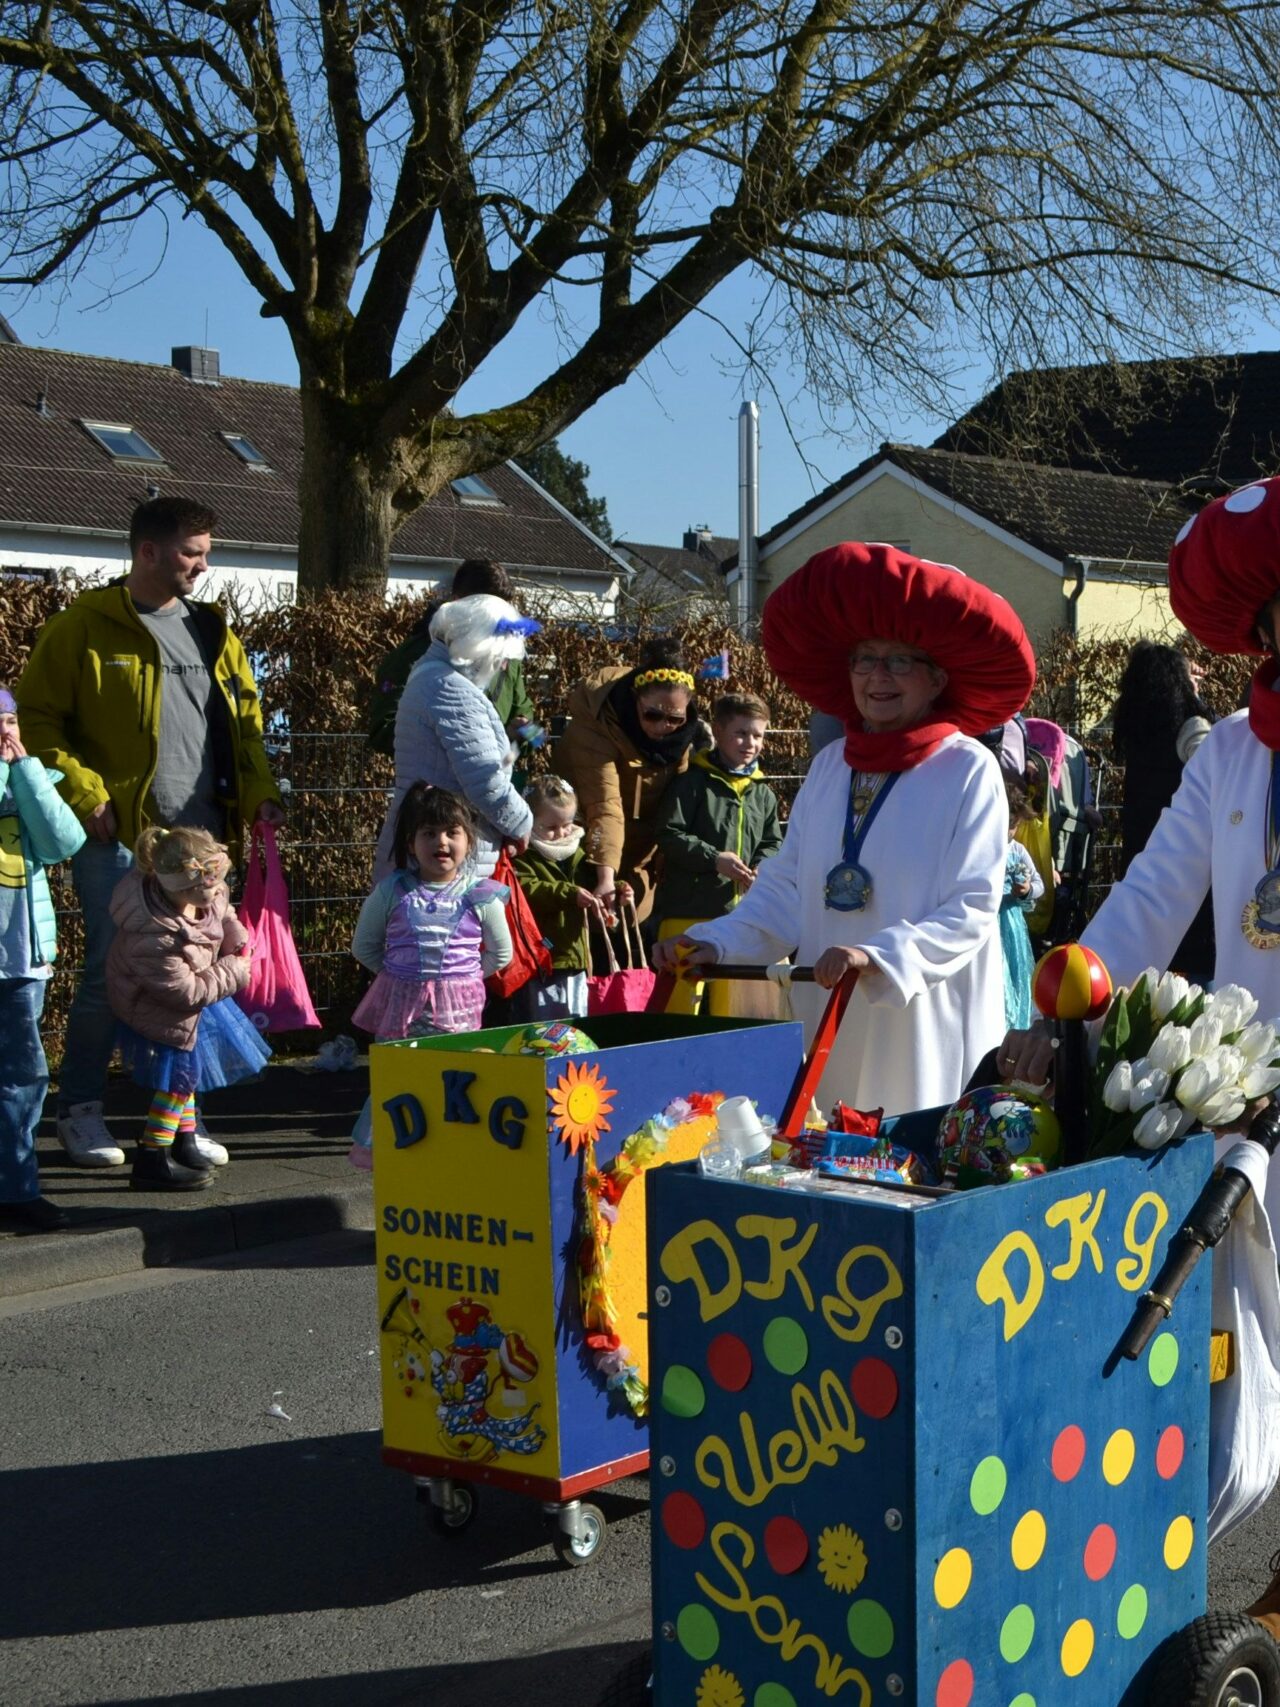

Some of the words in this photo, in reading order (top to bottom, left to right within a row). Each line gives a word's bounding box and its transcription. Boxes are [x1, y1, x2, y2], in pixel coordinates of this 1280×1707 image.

[382, 1069, 529, 1150] DKG
[383, 1205, 534, 1246] SONNEN-
[384, 1254, 500, 1296] SCHEIN
